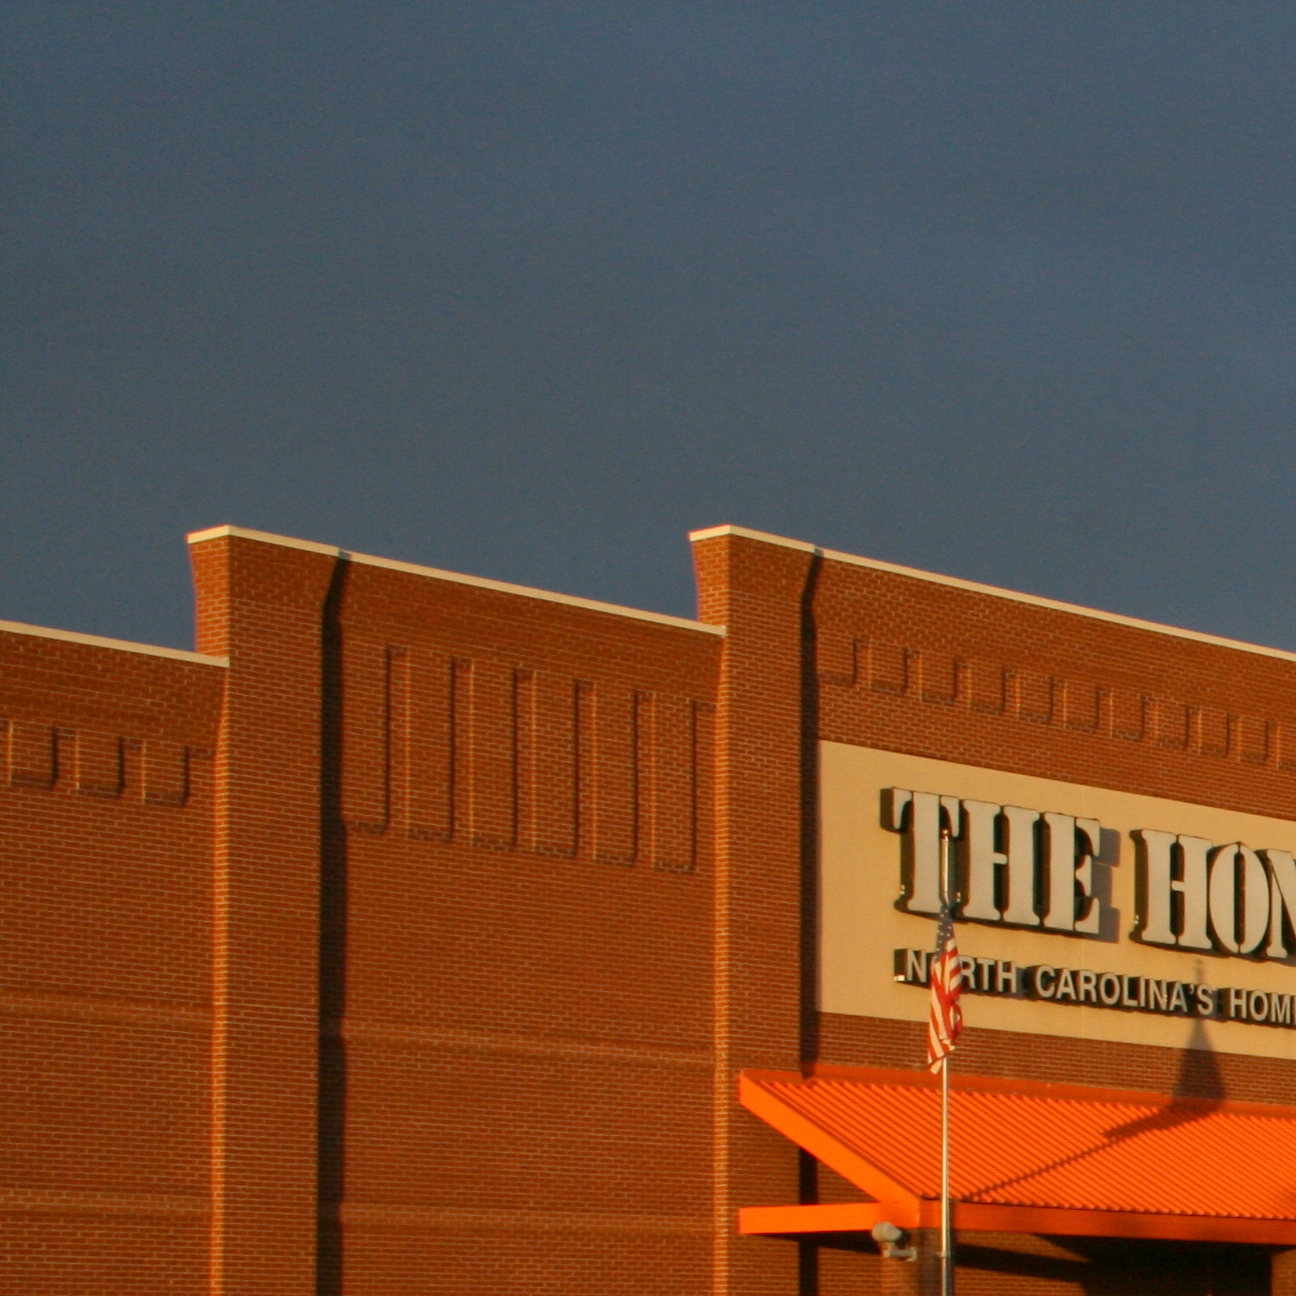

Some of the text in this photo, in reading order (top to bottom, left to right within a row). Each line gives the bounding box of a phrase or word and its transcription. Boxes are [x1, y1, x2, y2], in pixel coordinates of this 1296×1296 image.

[888, 787, 1101, 934] THE
[906, 949, 1018, 994] NRTH
[1035, 964, 1213, 1017] CAROLINA'S
